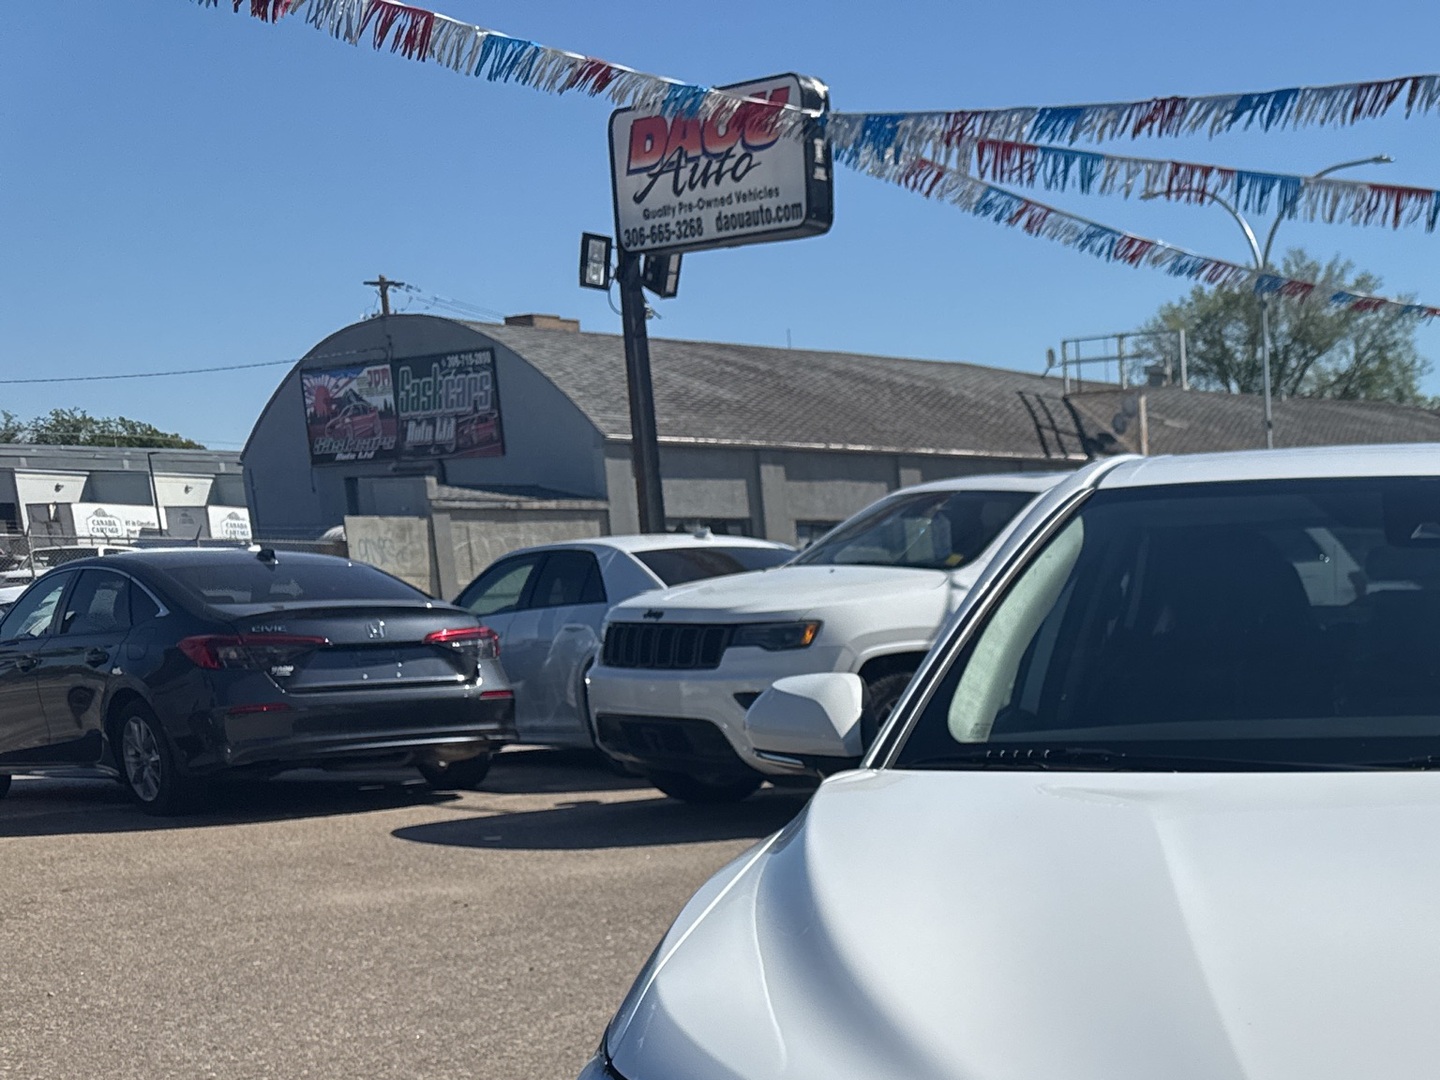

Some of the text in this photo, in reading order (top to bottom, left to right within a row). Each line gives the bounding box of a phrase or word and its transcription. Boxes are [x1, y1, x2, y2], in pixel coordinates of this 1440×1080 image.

[633, 146, 762, 205] Auto
[643, 186, 780, 220] Quality Pre-Owned Vehicles
[624, 202, 804, 248] 306-665-3268 daouauto.com
[91, 519, 117, 527] CANADA
[251, 624, 287, 633] CIVIC
